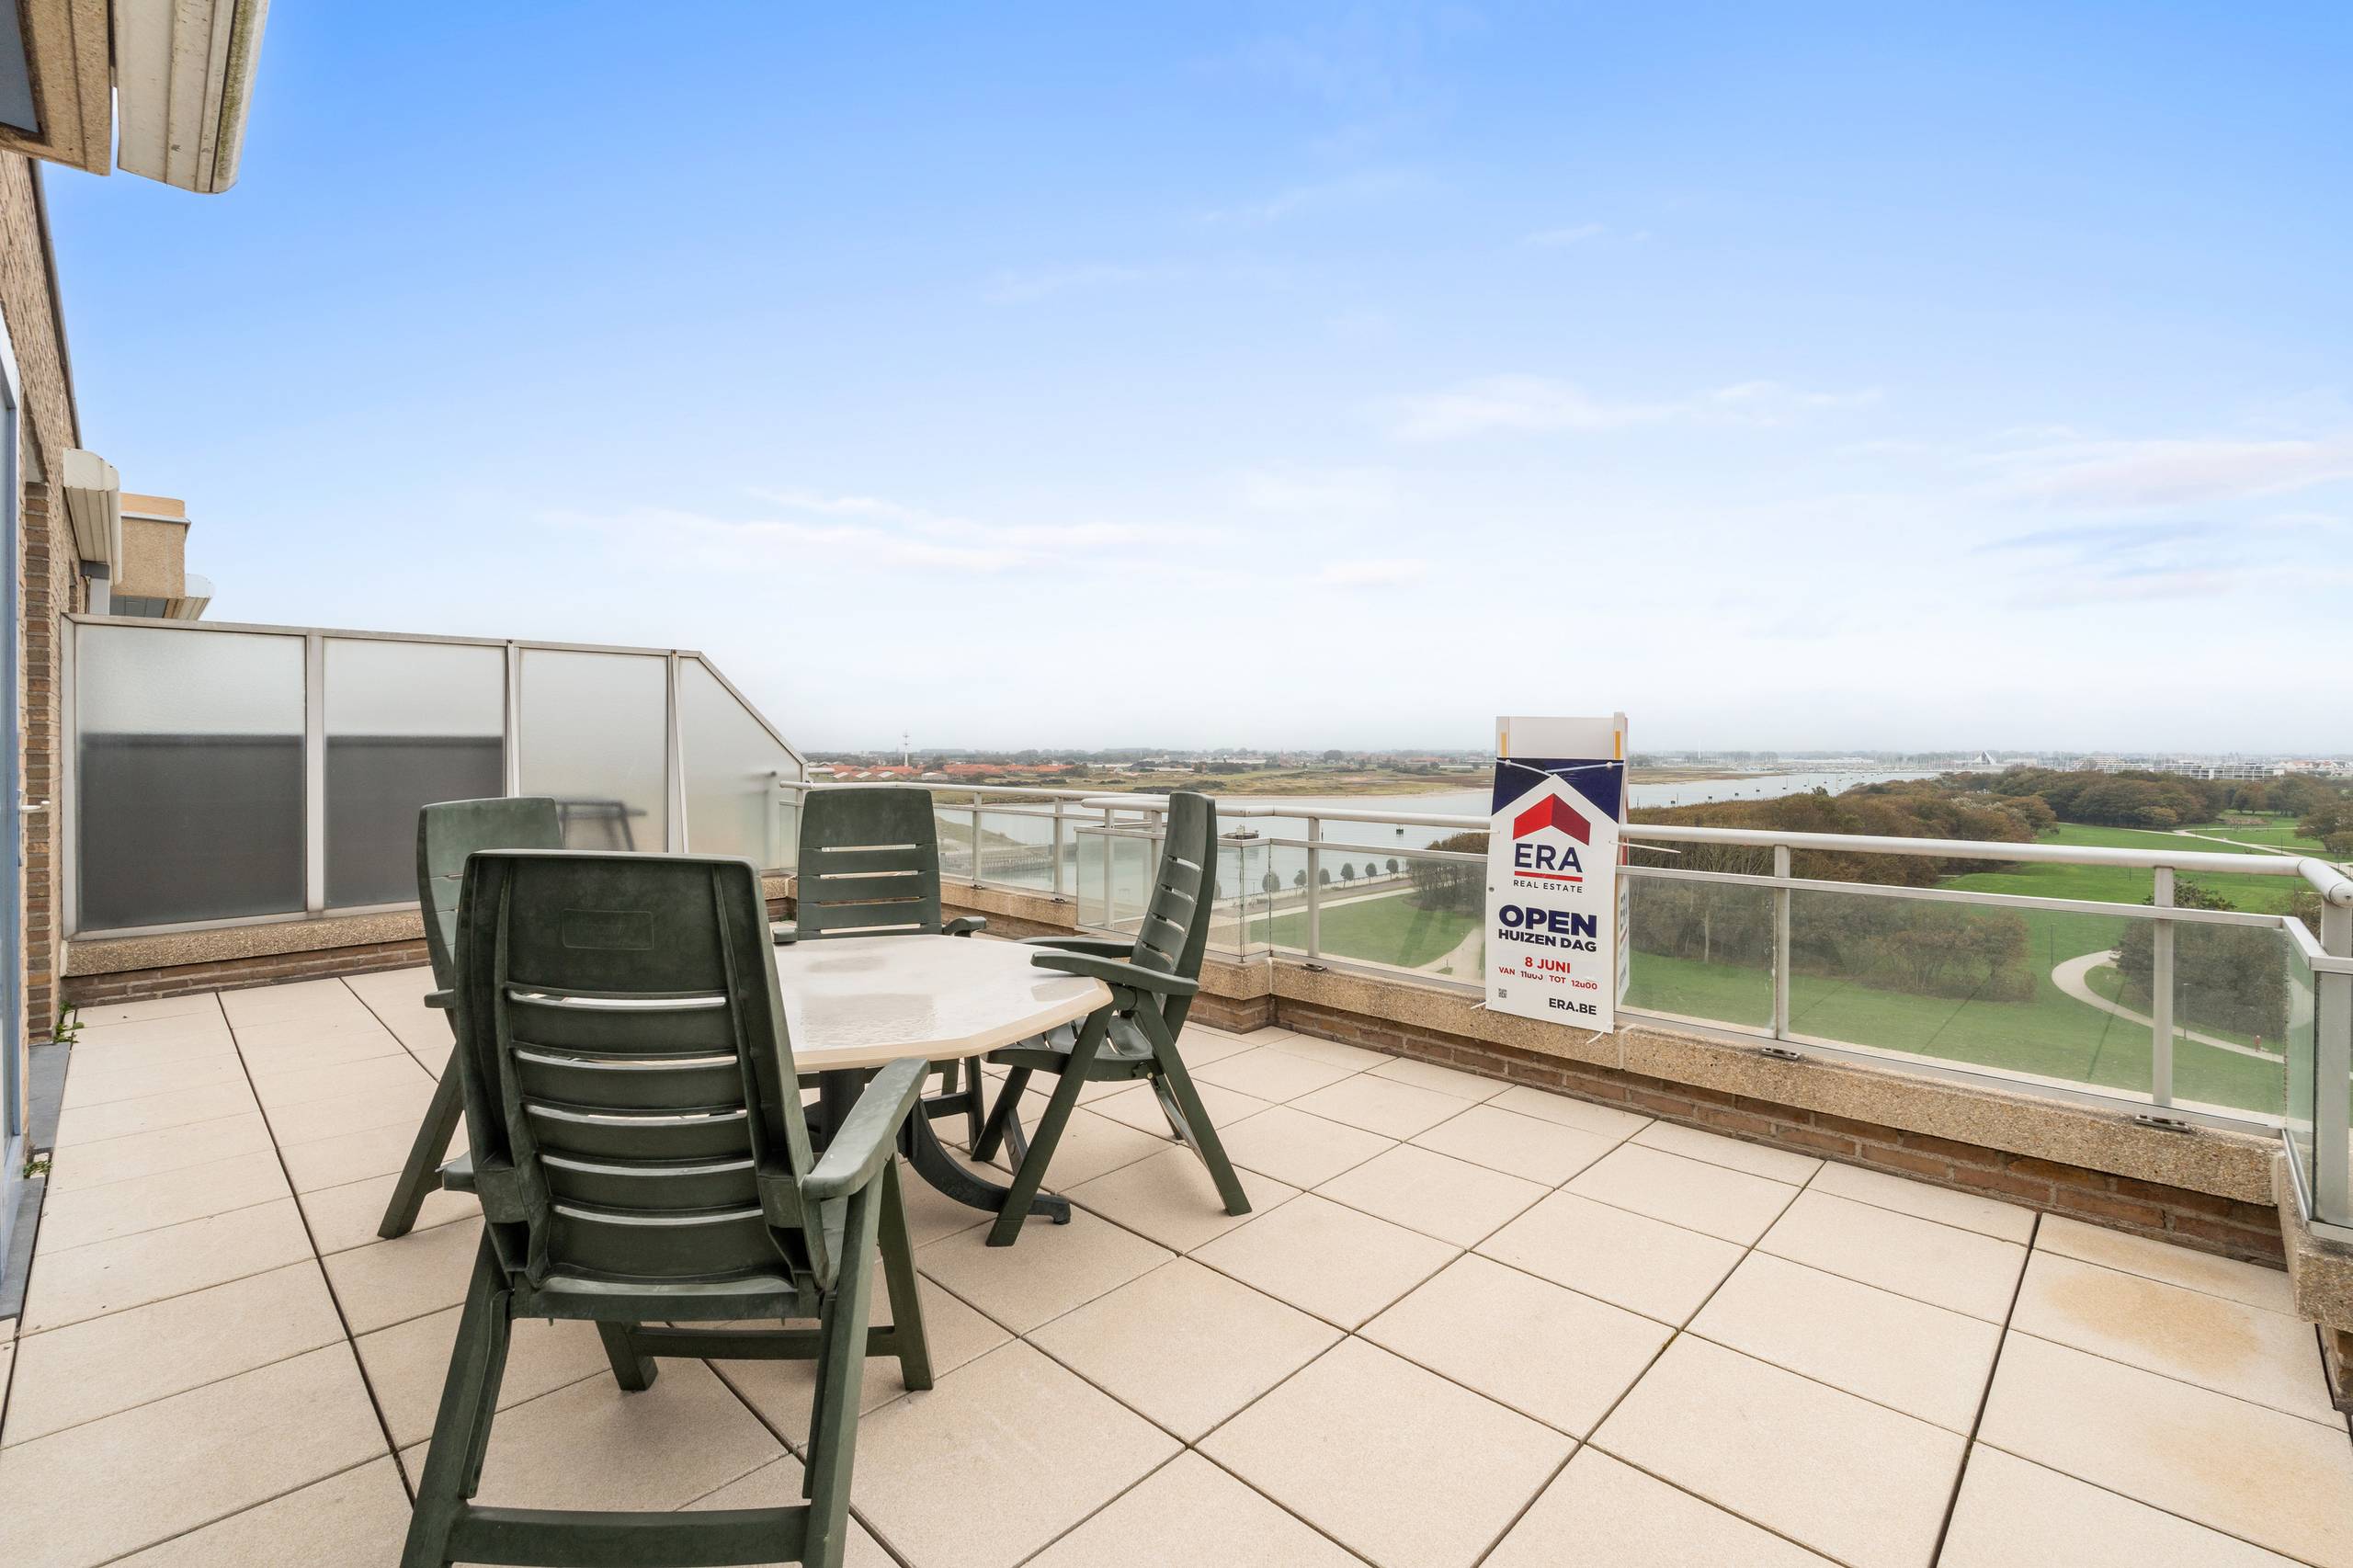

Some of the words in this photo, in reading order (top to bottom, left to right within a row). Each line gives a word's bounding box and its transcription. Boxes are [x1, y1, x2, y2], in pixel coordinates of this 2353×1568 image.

[1515, 843, 1583, 872] ERA
[1513, 880, 1539, 889] REAL
[1543, 882, 1583, 893] ESTATE
[1499, 904, 1597, 938] OPEN
[1498, 928, 1557, 947] HUIZEN
[1561, 937, 1597, 952] DAG
[1525, 956, 1533, 968] 8
[1537, 959, 1571, 974] JUNI
[1498, 966, 1516, 975] VAN
[1549, 974, 1566, 984] TOT
[1571, 979, 1597, 990] 12u00
[1549, 997, 1597, 1016] ERA.BE
